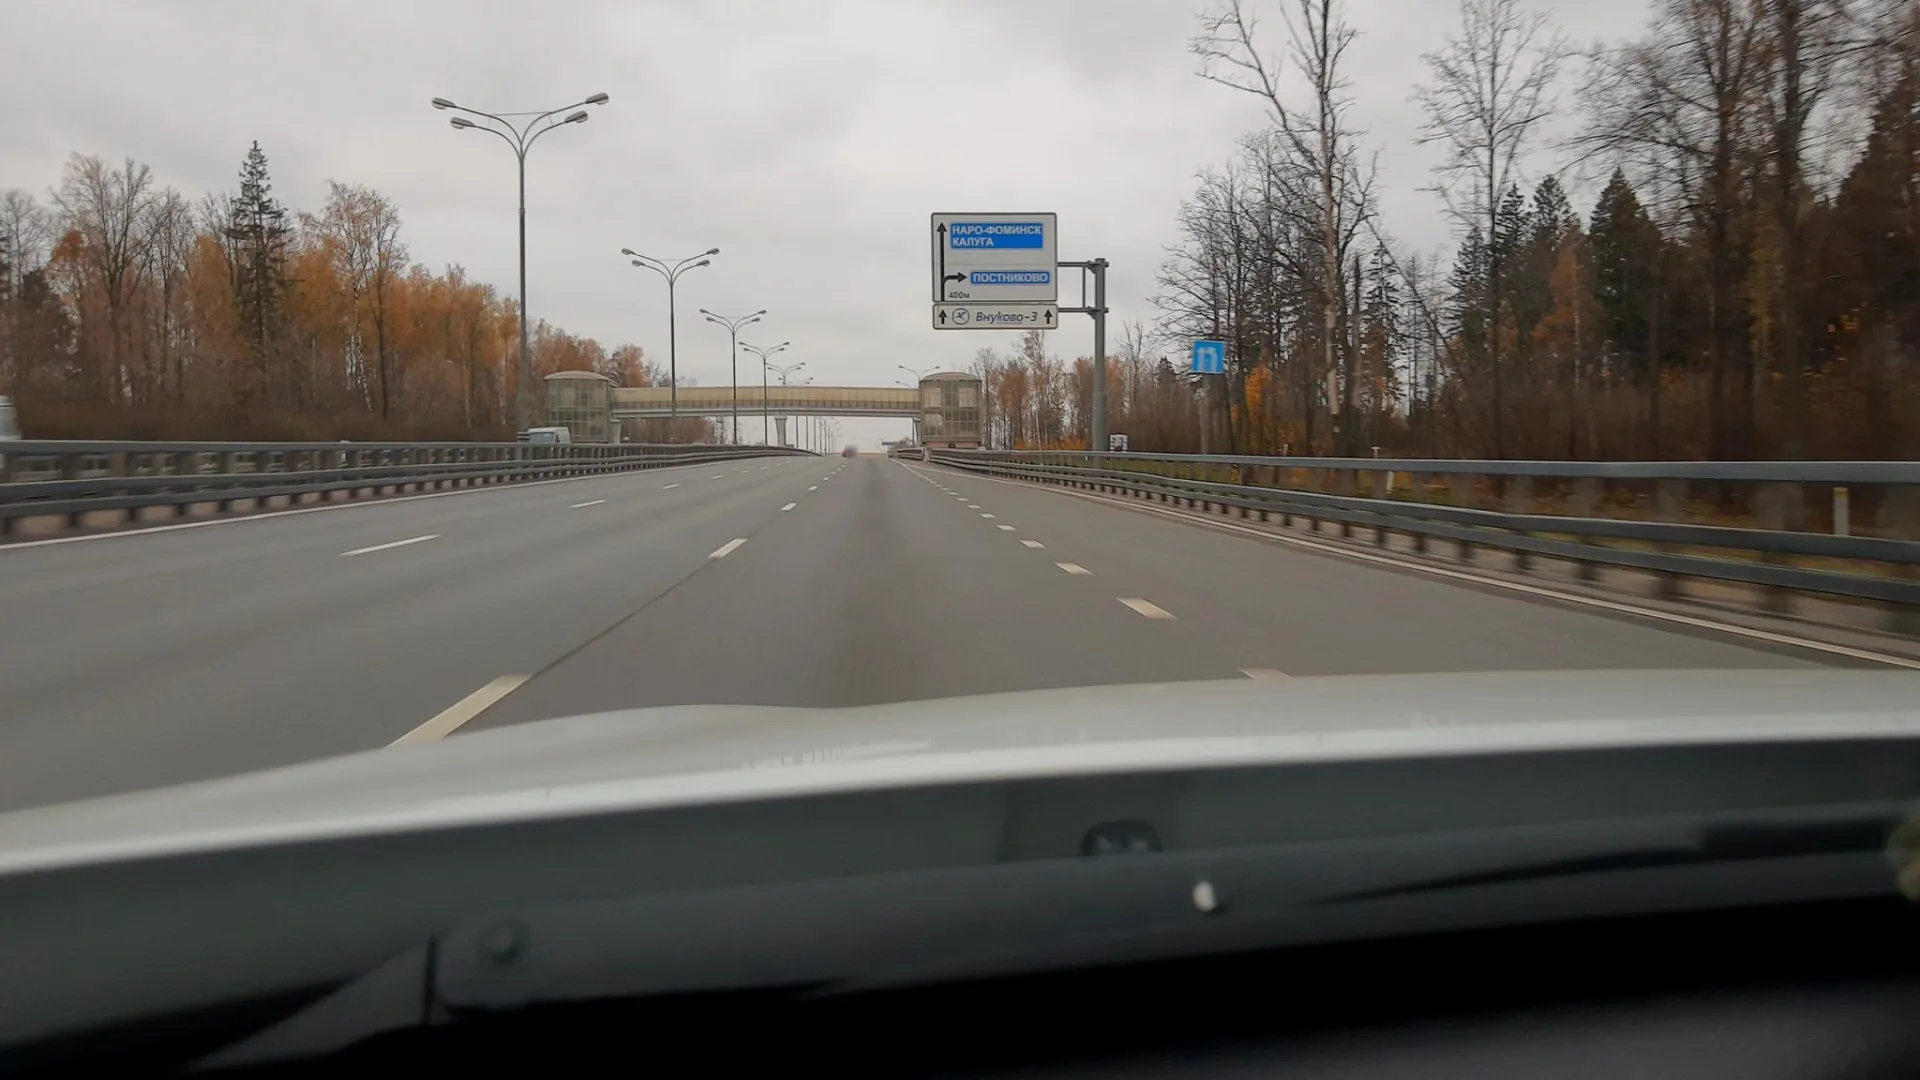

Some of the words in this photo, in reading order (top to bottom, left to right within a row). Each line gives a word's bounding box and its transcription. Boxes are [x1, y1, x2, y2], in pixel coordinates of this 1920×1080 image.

[952, 225, 1042, 235] НАРО-ФОМИНСК
[952, 237, 994, 246] КАЛУГА
[972, 273, 1049, 283] ПОСТНИКОВО
[948, 291, 970, 299] 400м
[975, 311, 1038, 324] Внуково-3
